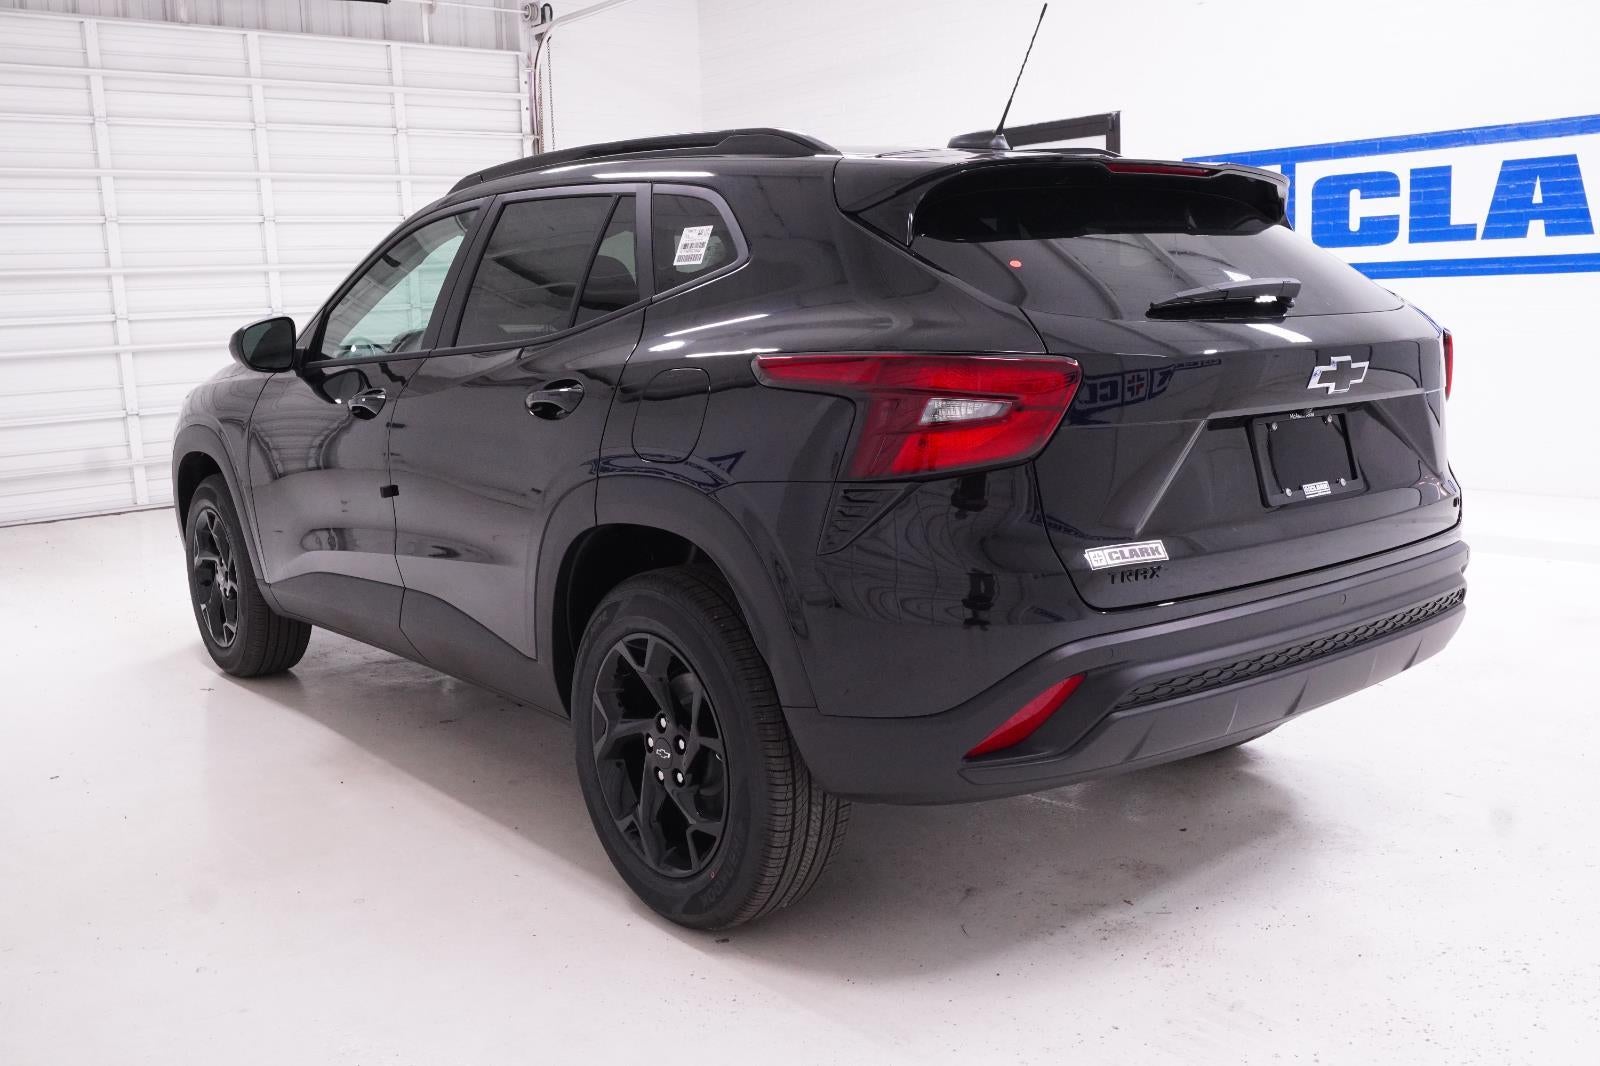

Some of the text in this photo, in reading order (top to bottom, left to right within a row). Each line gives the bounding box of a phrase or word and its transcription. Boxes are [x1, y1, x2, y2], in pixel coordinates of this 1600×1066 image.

[1311, 154, 1600, 248] CLA
[1107, 545, 1162, 561] CLARK
[1108, 565, 1163, 584] TRAX
